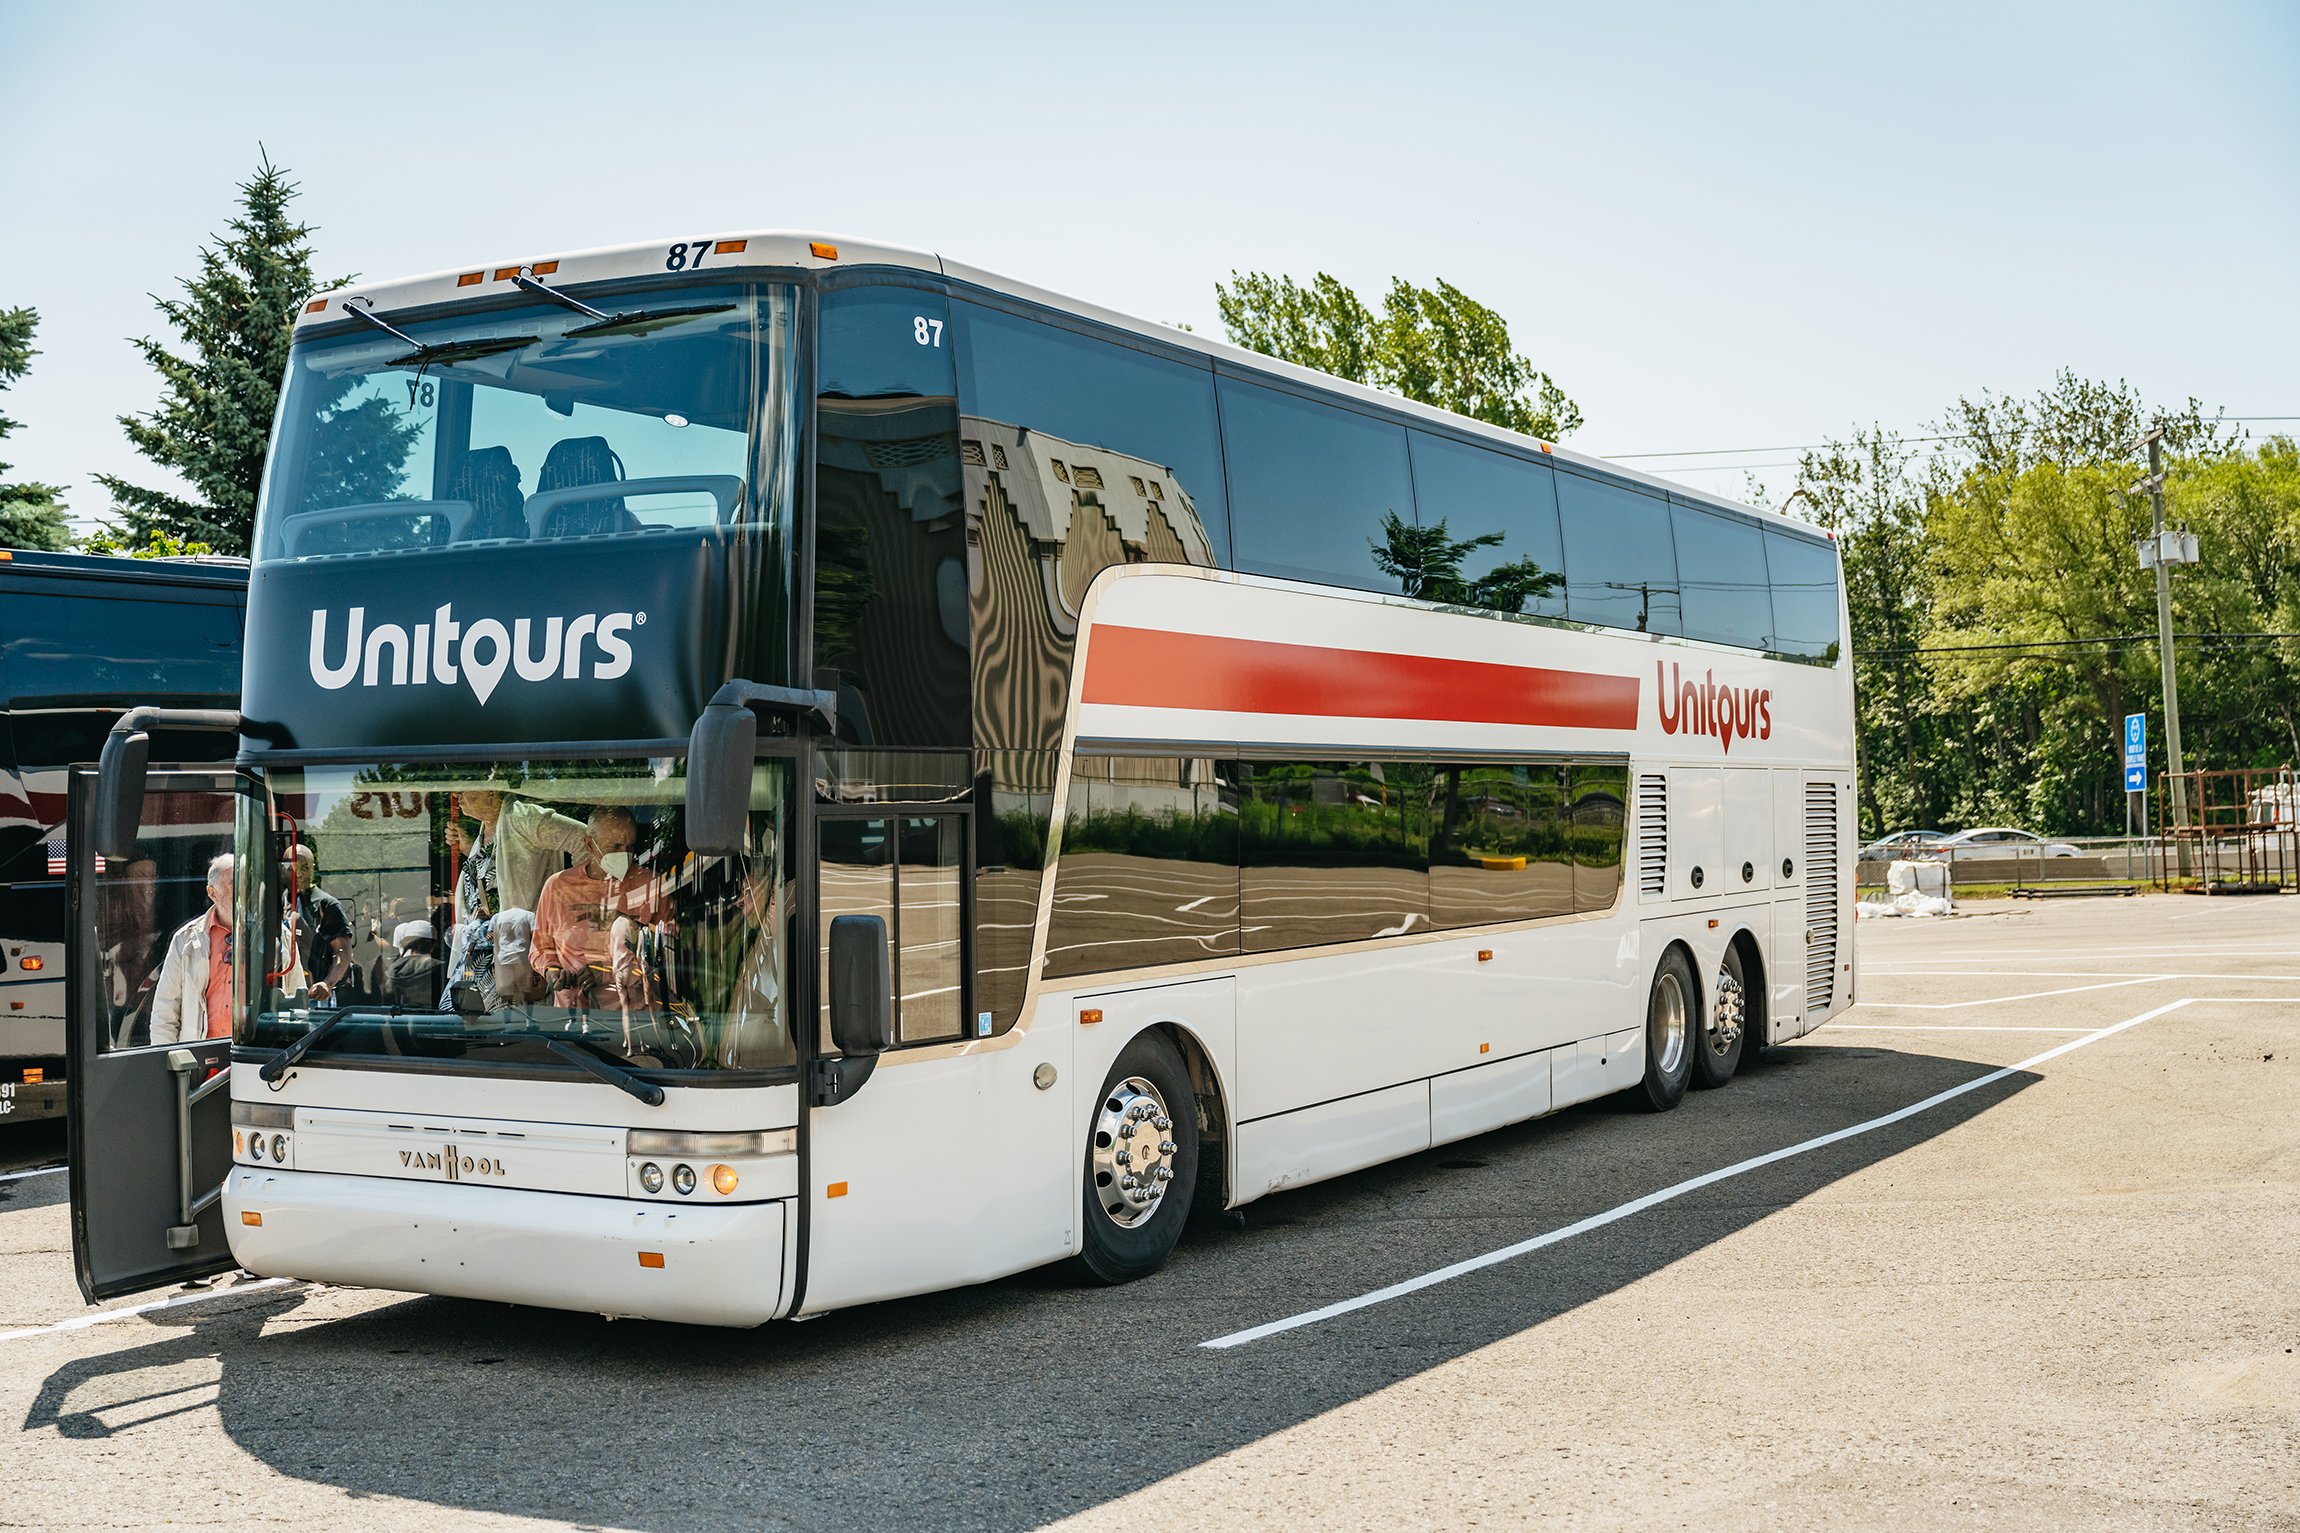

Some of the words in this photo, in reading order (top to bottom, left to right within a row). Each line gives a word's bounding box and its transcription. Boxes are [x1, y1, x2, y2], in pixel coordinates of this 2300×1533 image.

[666, 240, 713, 271] 87
[913, 316, 943, 347] 87
[310, 602, 633, 706] Unitours
[1657, 660, 1771, 756] Unitours
[0, 1083, 15, 1098] 91
